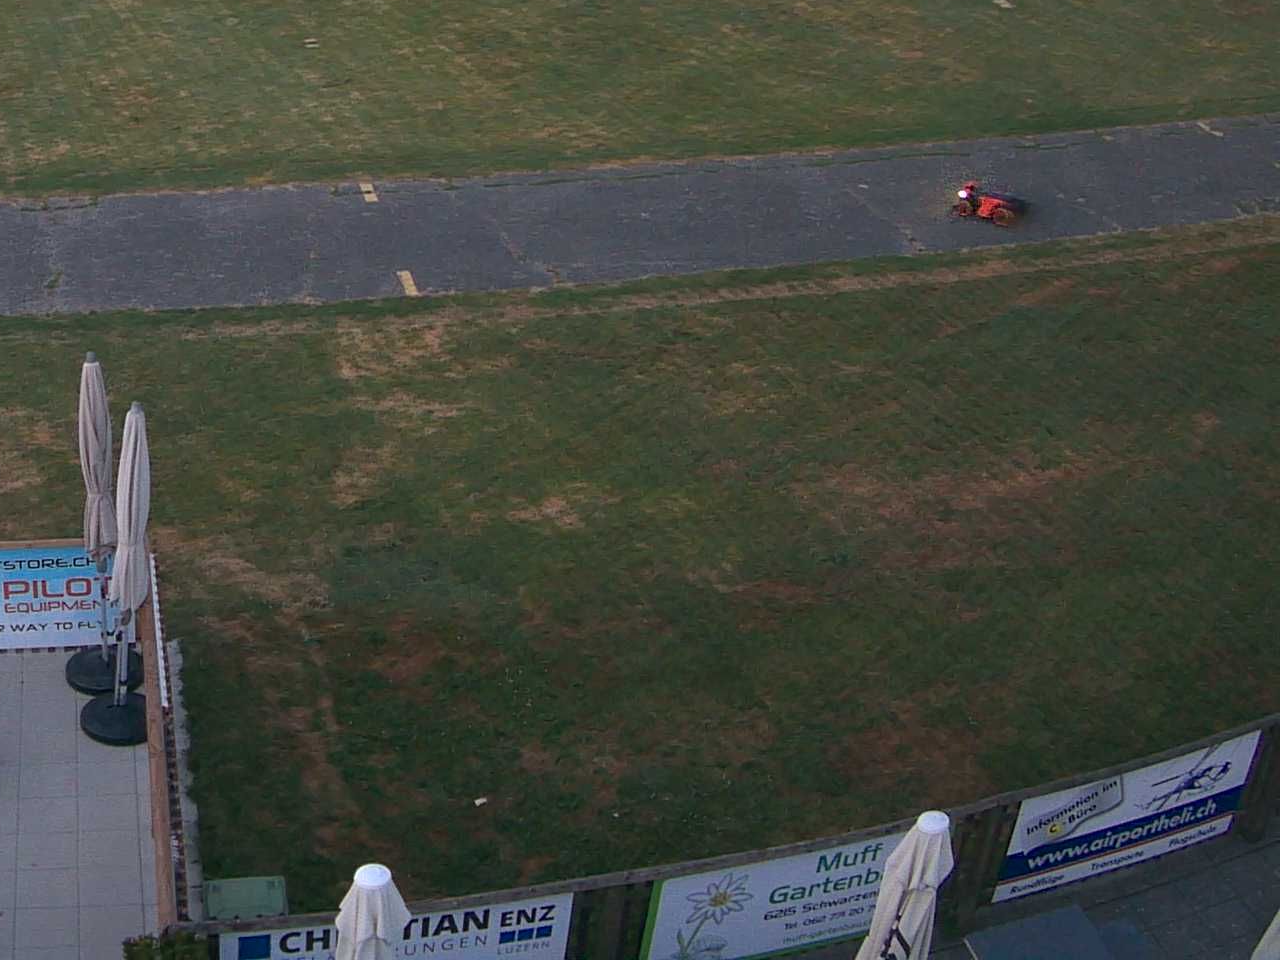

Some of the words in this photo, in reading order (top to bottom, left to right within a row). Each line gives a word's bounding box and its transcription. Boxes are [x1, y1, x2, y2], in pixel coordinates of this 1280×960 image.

[10, 622, 50, 633] WAY
[54, 621, 74, 630] TO
[1026, 790, 1099, 835] Information
[1102, 780, 1118, 793] im
[1028, 799, 1217, 870] www.airportheli.ch
[816, 843, 884, 873] Muff
[500, 904, 556, 928] ENZ
[763, 906, 797, 921] 6215
[497, 941, 551, 955] LUZERN
